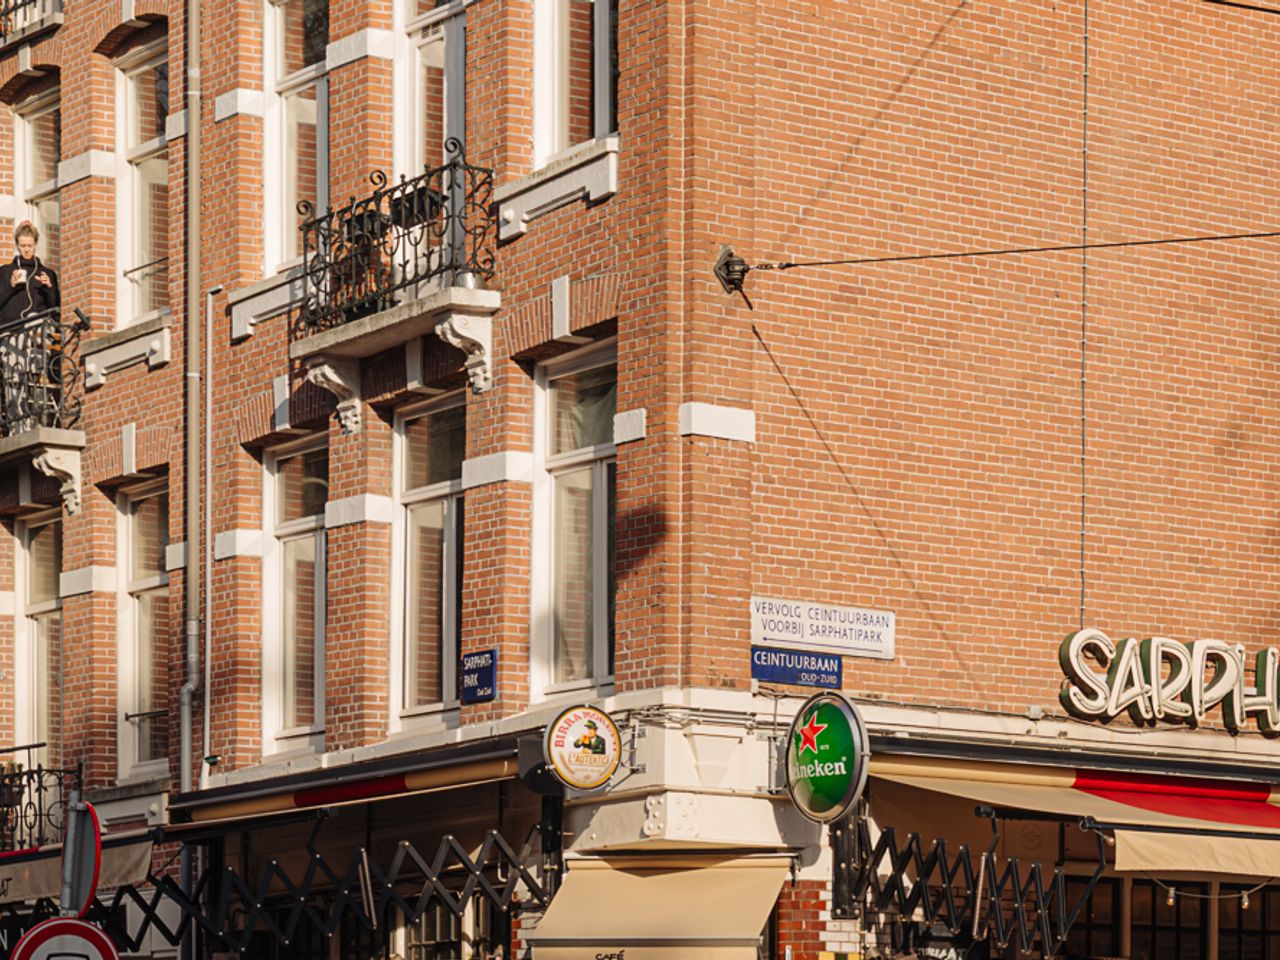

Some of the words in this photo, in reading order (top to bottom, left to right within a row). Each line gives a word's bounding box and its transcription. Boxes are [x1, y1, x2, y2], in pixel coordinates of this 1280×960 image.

[754, 601, 801, 618] VERVOLG
[808, 607, 889, 628] CEINTUURBAAN
[761, 618, 804, 639] VOORBIJ
[809, 623, 882, 643] SARPHATIPARK
[754, 651, 838, 672] CEINTUURBAAN
[464, 673, 478, 688] PARK
[555, 713, 582, 748] BIRRA
[595, 949, 625, 960] CAFÉ
